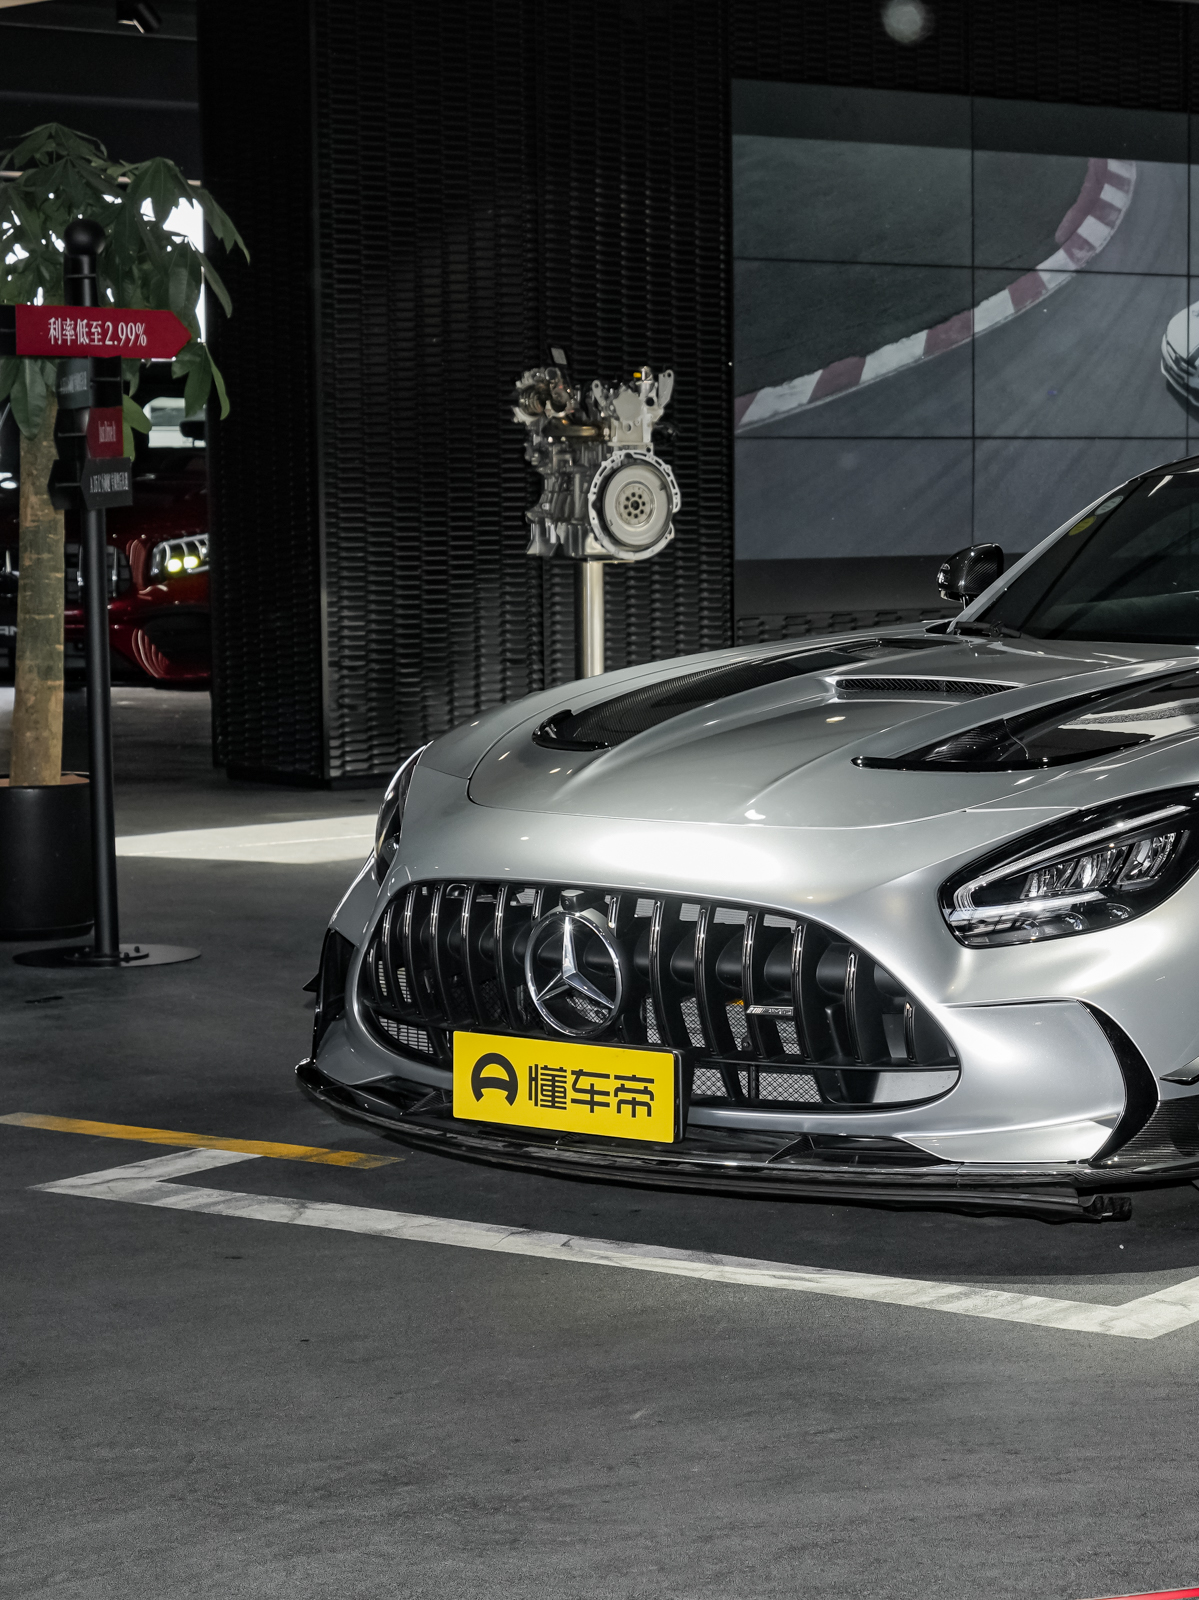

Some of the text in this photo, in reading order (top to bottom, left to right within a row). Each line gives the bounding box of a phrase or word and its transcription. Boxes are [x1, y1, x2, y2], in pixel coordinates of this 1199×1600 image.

[48, 317, 147, 347] 利率低至2.99%
[528, 1063, 655, 1118] 懂车帝
